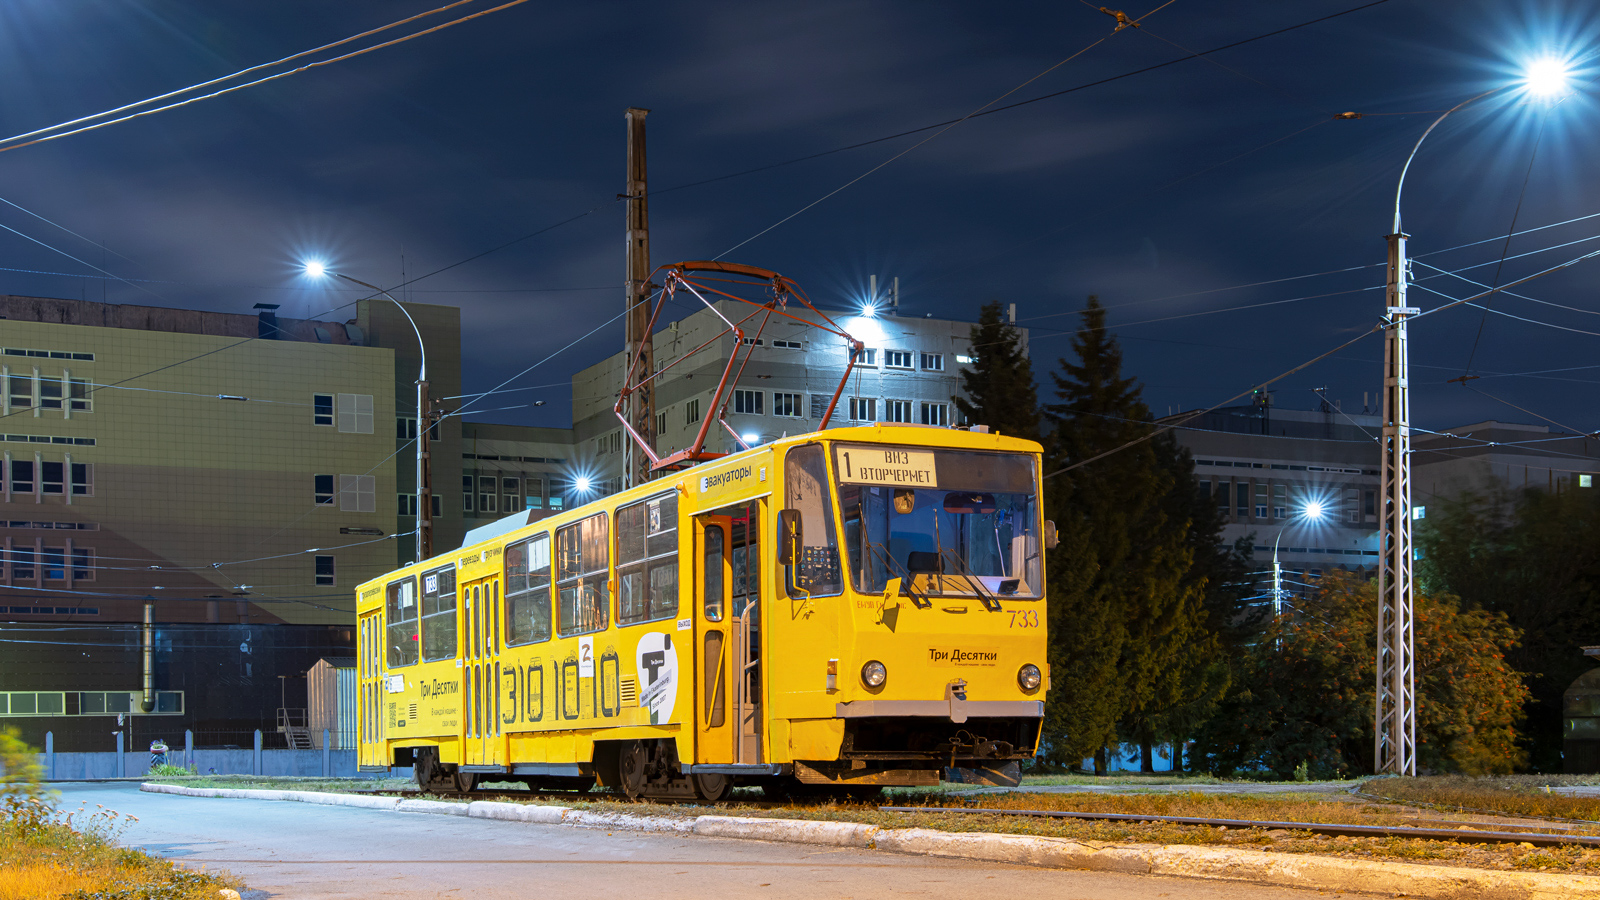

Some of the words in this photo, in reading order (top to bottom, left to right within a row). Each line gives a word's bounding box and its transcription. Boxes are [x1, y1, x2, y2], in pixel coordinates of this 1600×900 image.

[843, 451, 852, 478] 1
[884, 450, 909, 465] ВИЗ
[704, 465, 752, 489] эвакуаторы
[860, 467, 930, 483] ВТОРЧЕРМЕТ
[426, 576, 437, 592] 733
[1006, 609, 1039, 629] 733
[581, 643, 591, 662] 2
[928, 648, 948, 662] Три
[950, 648, 997, 662] Десятки
[420, 680, 431, 700] Три
[432, 679, 458, 699] Десятки
